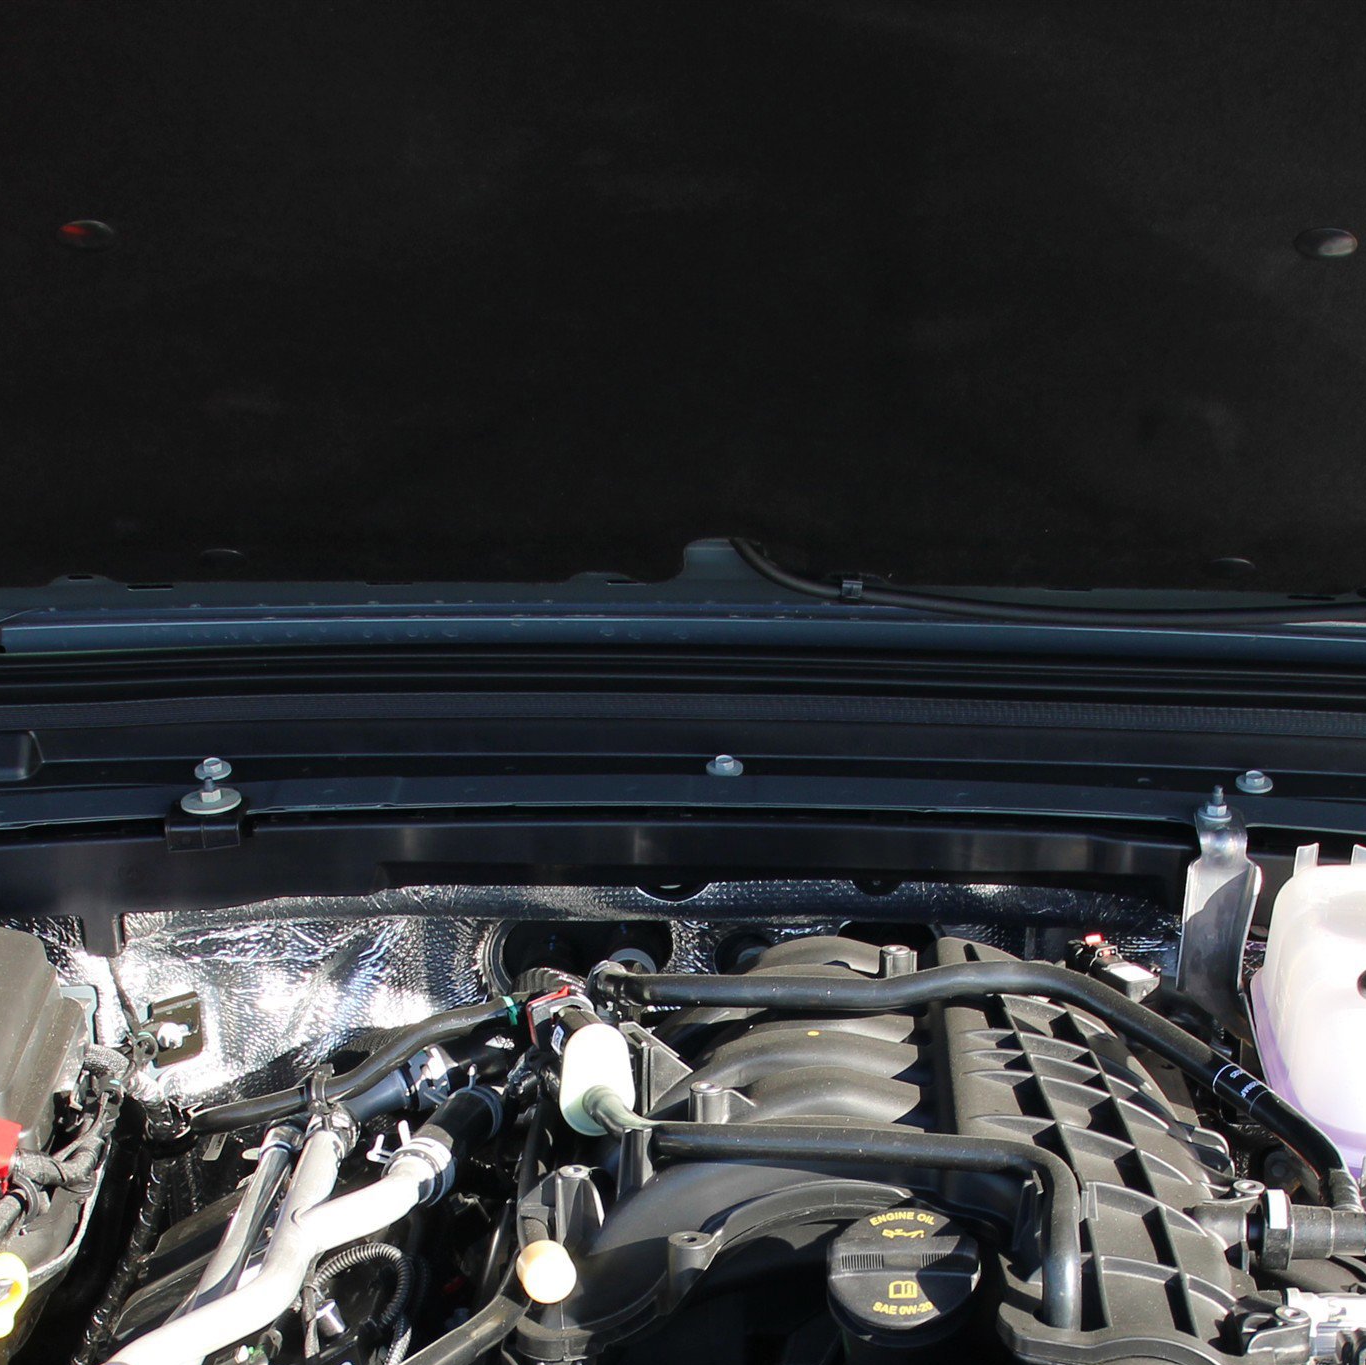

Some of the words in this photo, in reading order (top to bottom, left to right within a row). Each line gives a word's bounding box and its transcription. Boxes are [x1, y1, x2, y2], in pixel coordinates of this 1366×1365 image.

[869, 1211, 915, 1227] ENGINE
[916, 1212, 936, 1226] OIL
[872, 1301, 899, 1315] SAE
[898, 1301, 934, 1315] 0W-20
